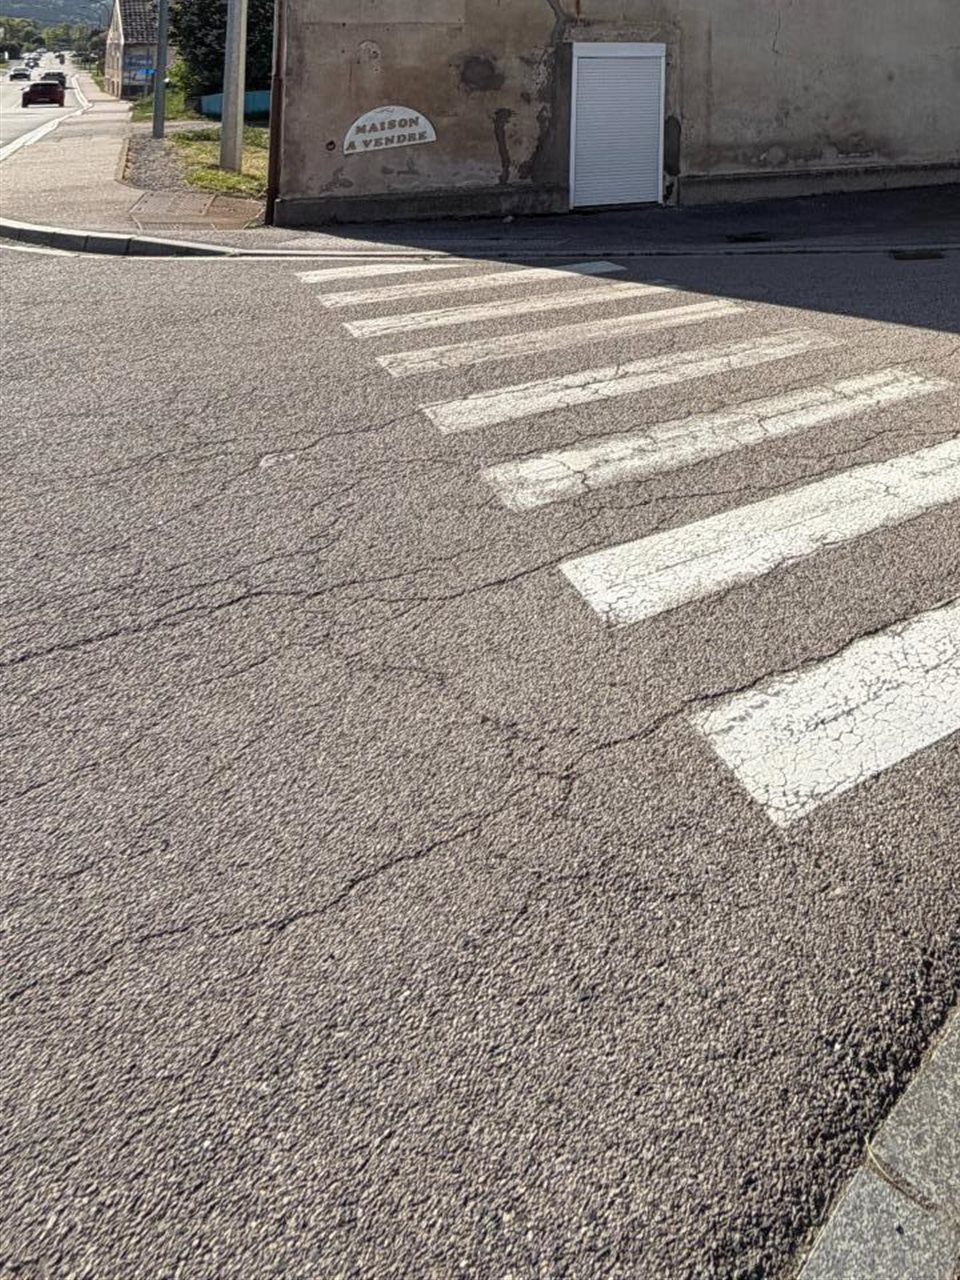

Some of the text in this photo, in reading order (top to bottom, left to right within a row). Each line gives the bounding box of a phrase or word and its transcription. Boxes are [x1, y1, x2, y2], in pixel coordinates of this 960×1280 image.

[355, 117, 420, 135] MAISON
[345, 131, 427, 151] A VENDRE
